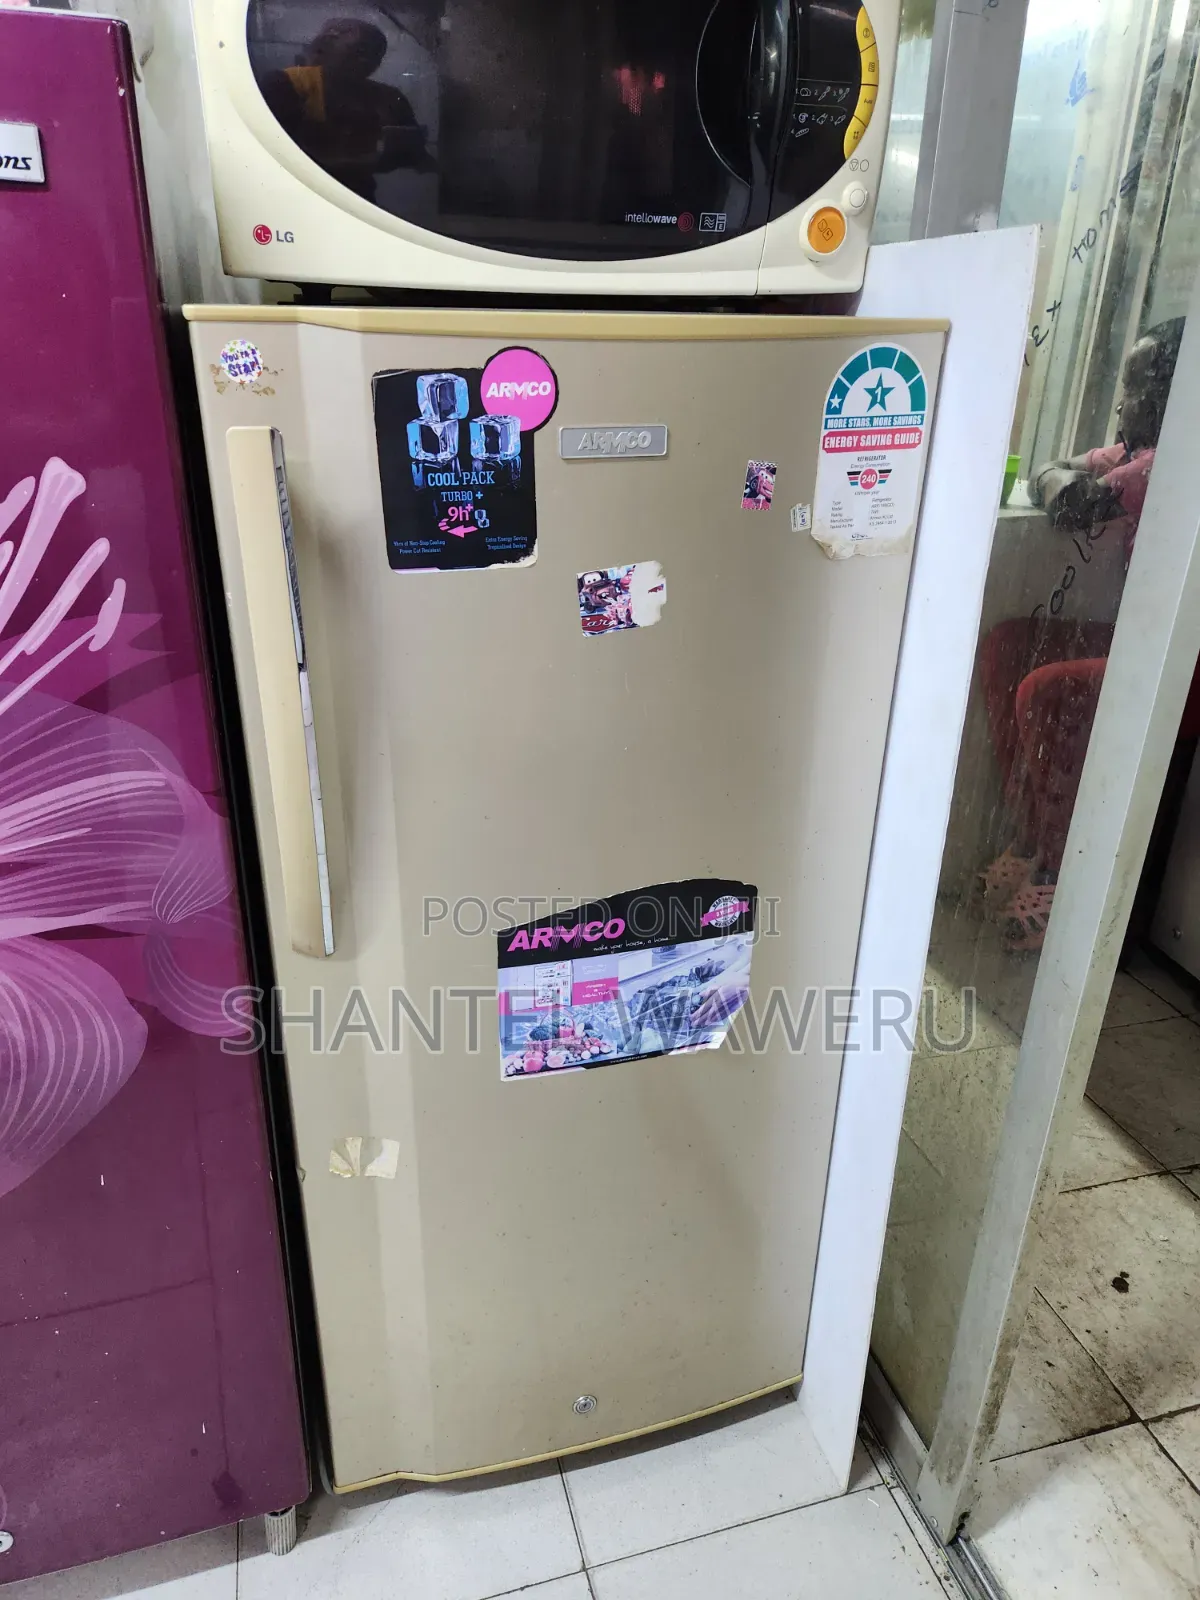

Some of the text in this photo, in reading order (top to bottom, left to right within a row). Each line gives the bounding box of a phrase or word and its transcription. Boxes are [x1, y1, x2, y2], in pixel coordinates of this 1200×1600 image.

[625, 212, 678, 224] intellowave
[276, 230, 295, 243] LG
[486, 381, 551, 400] ARMCO
[875, 386, 882, 403] 1
[827, 418, 847, 429] MORE
[872, 416, 892, 426] MORE
[893, 415, 922, 426] SAVINGS
[578, 430, 651, 453] ARMCO
[824, 432, 920, 448] ENERGY SAVING GUIDE
[427, 470, 495, 487] COOL PACK
[861, 474, 876, 484] 240
[441, 490, 473, 502] TURBO
[507, 918, 625, 952] ARMCO
